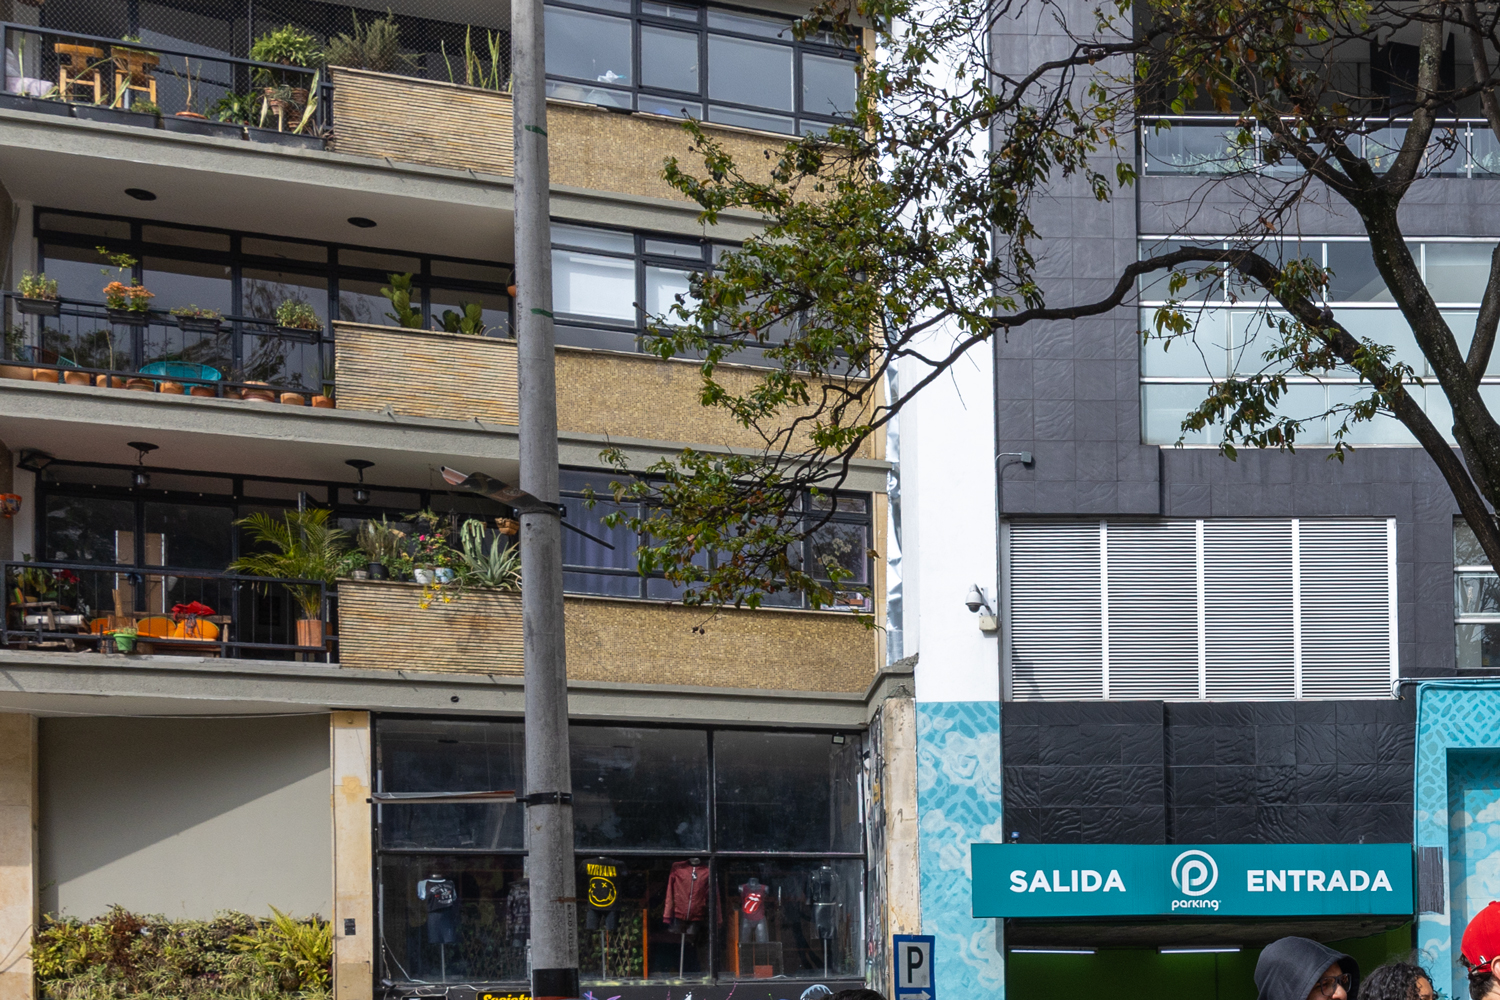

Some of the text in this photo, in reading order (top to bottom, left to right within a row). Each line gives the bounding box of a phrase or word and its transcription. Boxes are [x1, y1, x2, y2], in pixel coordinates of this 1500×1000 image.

[586, 863, 617, 877] NIRVANA
[1009, 869, 1126, 893] SALIDA
[1247, 869, 1393, 893] ENTRADA
[907, 945, 924, 983] P
